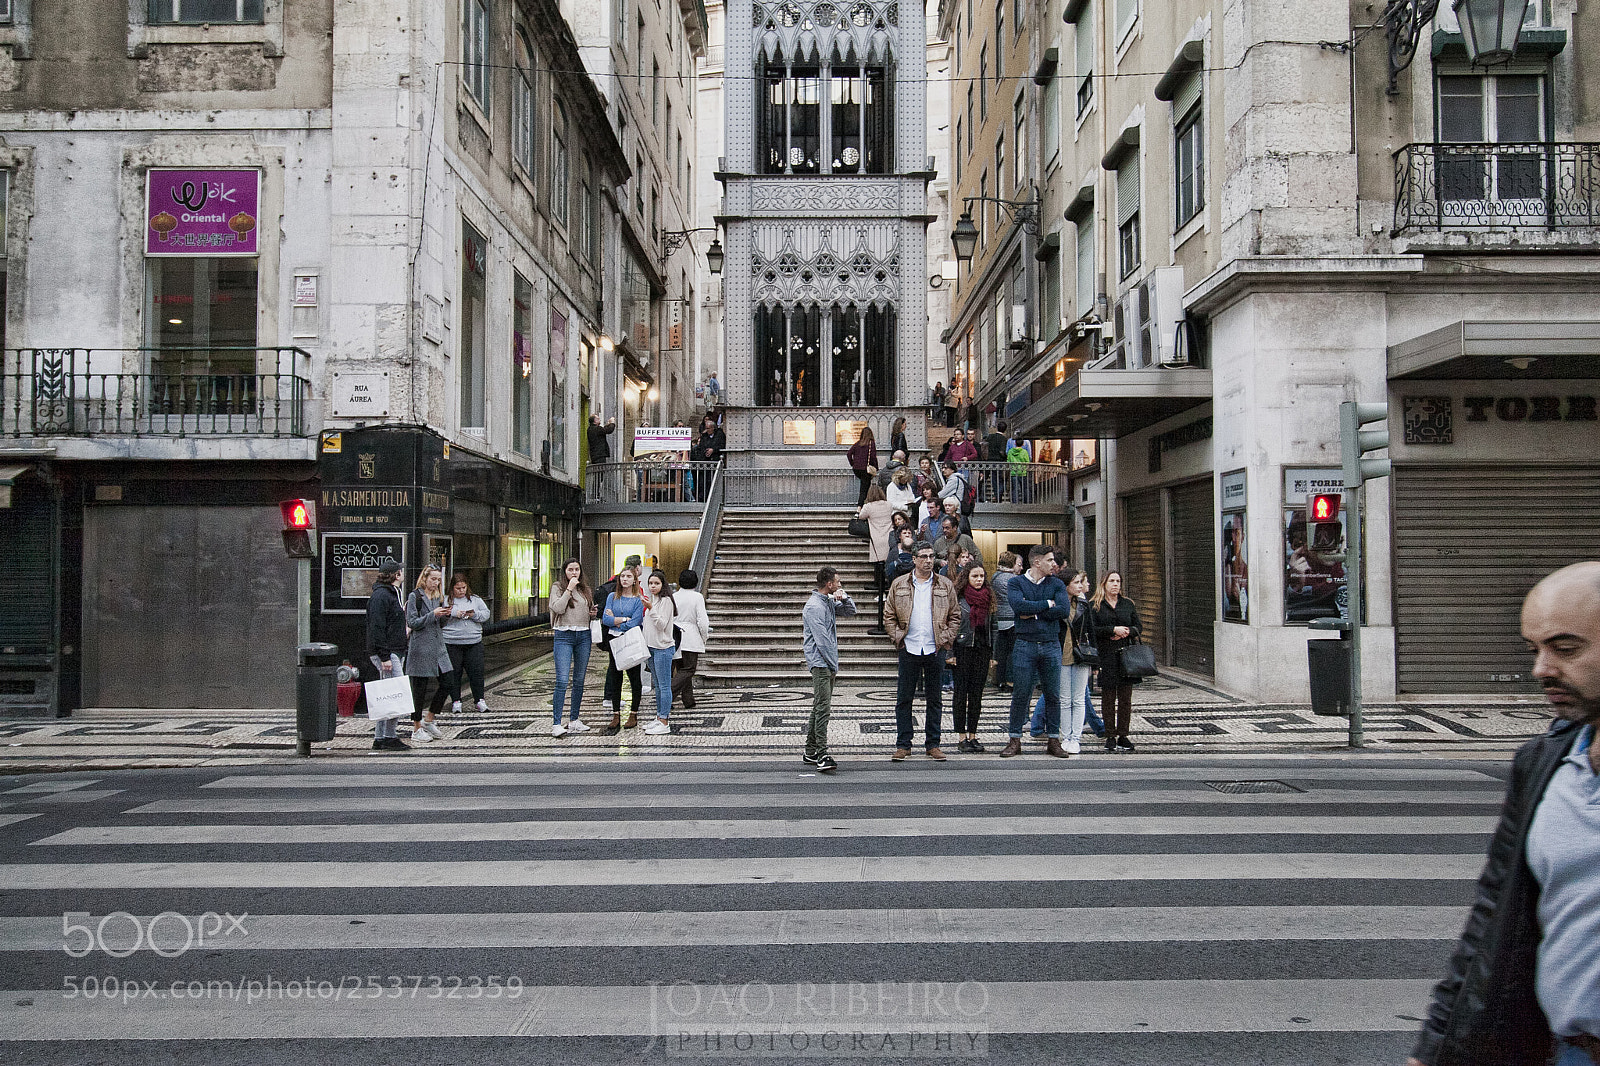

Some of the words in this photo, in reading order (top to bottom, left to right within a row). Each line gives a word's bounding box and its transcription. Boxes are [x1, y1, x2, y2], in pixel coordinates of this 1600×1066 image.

[181, 213, 225, 222] Oriental
[170, 232, 235, 246] 大世界餐厅
[349, 394, 372, 402] ÁUREA
[333, 544, 378, 556] ESPAÇO
[376, 692, 403, 701] MANGO
